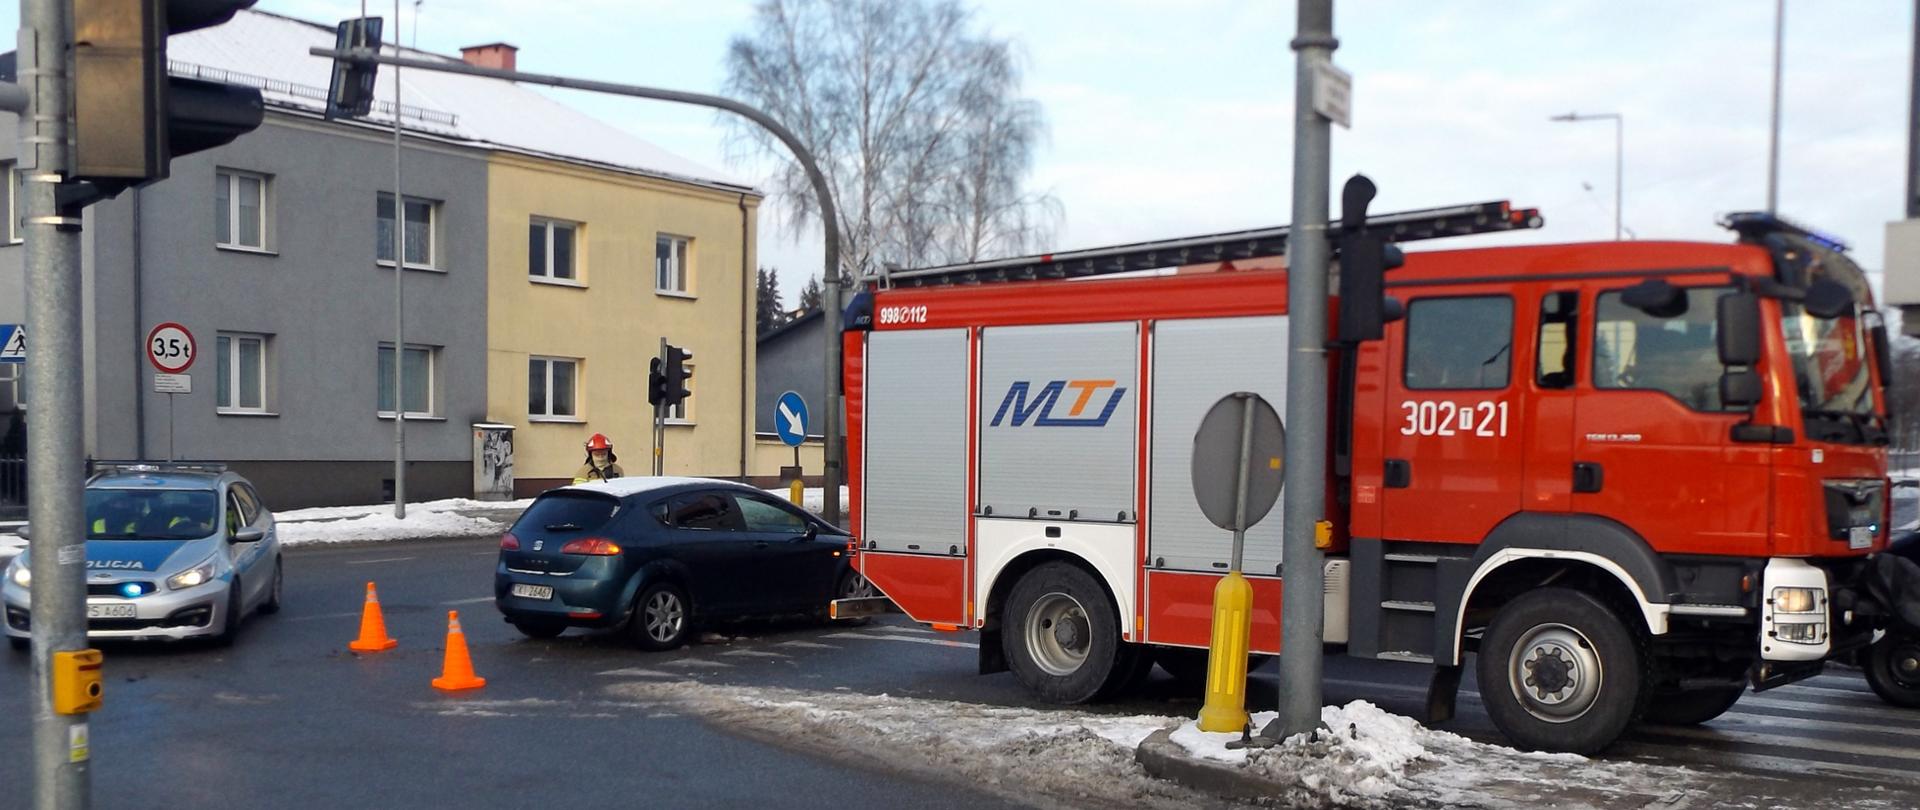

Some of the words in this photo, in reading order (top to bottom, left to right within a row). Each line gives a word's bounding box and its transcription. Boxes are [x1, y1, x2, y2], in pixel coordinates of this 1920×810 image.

[880, 307, 899, 324] 998
[911, 305, 927, 323] 112
[153, 337, 180, 359] 3,5
[183, 344, 190, 358] t
[1400, 400, 1456, 436] 302
[1476, 401, 1508, 437] 21
